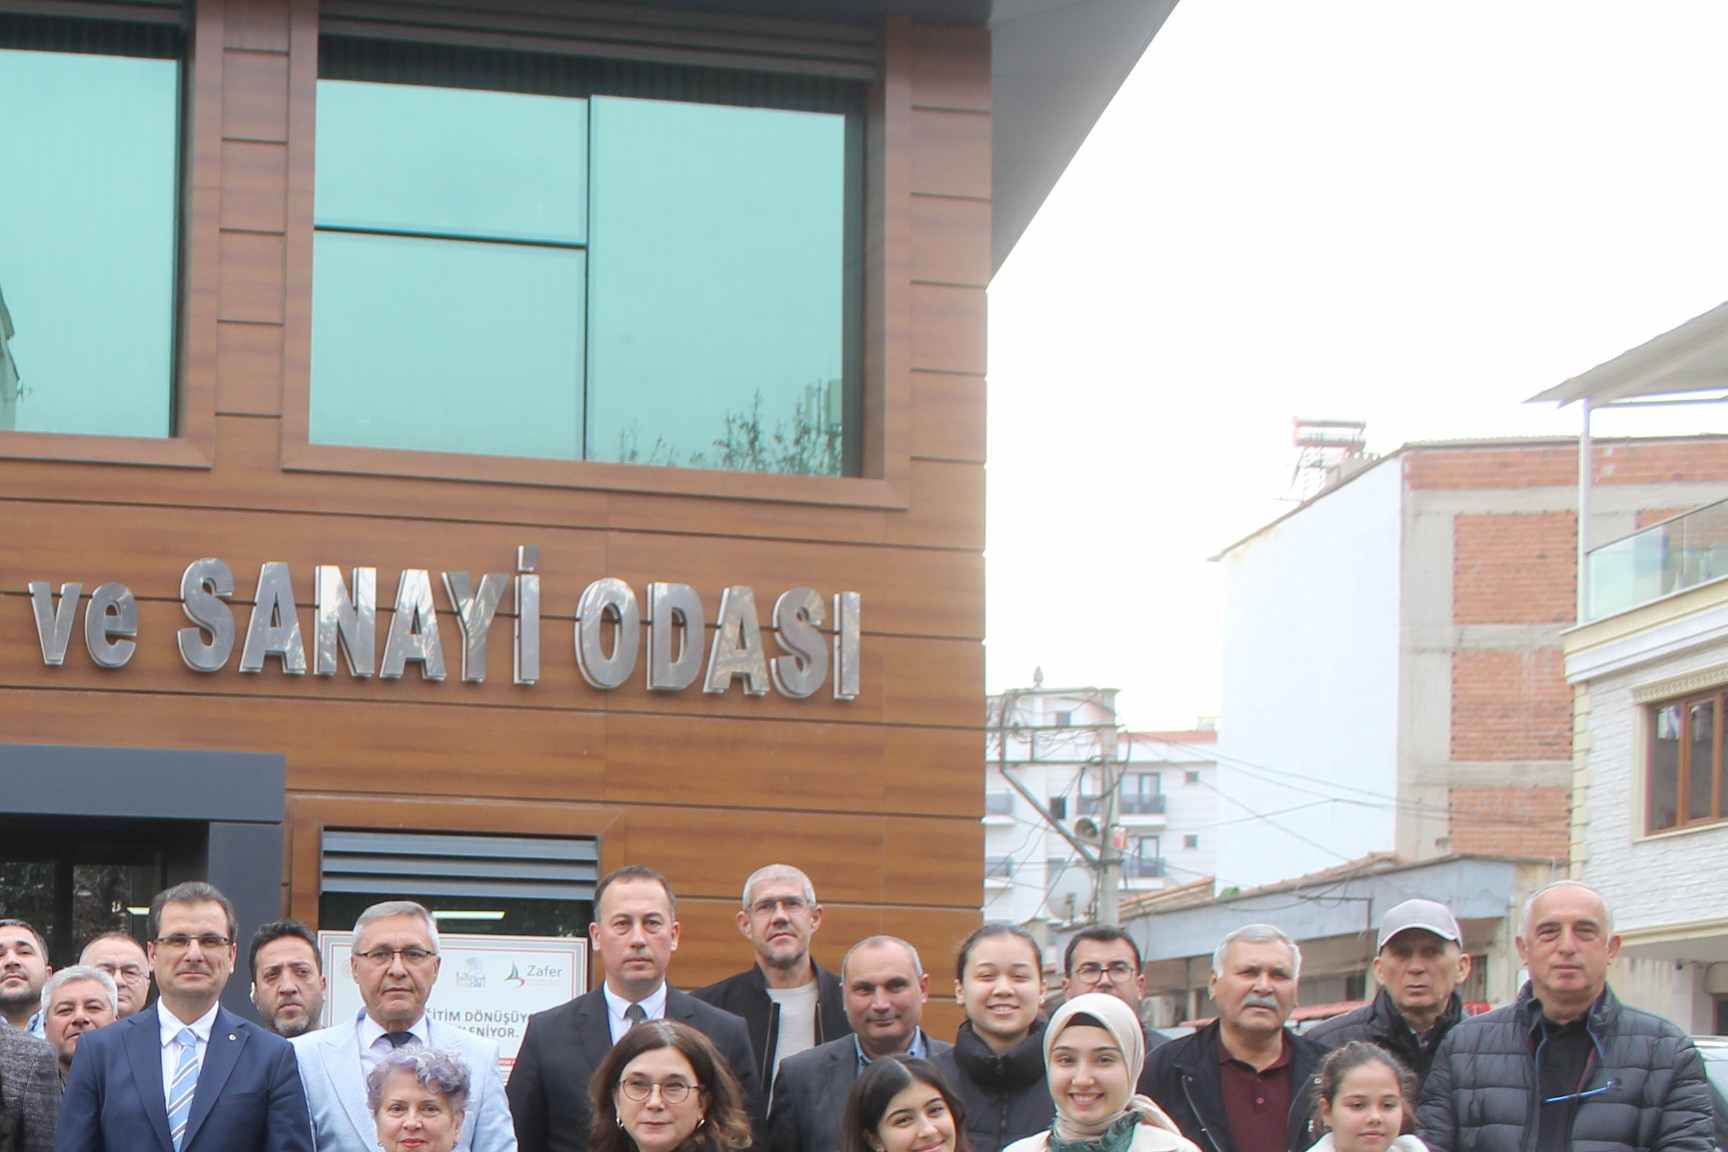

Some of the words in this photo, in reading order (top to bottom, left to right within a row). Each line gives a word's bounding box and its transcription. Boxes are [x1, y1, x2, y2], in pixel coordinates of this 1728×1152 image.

[27, 581, 138, 668] ve
[177, 545, 540, 685] SANAYİ
[574, 577, 861, 701] ODASI
[527, 964, 562, 977] Zafer
